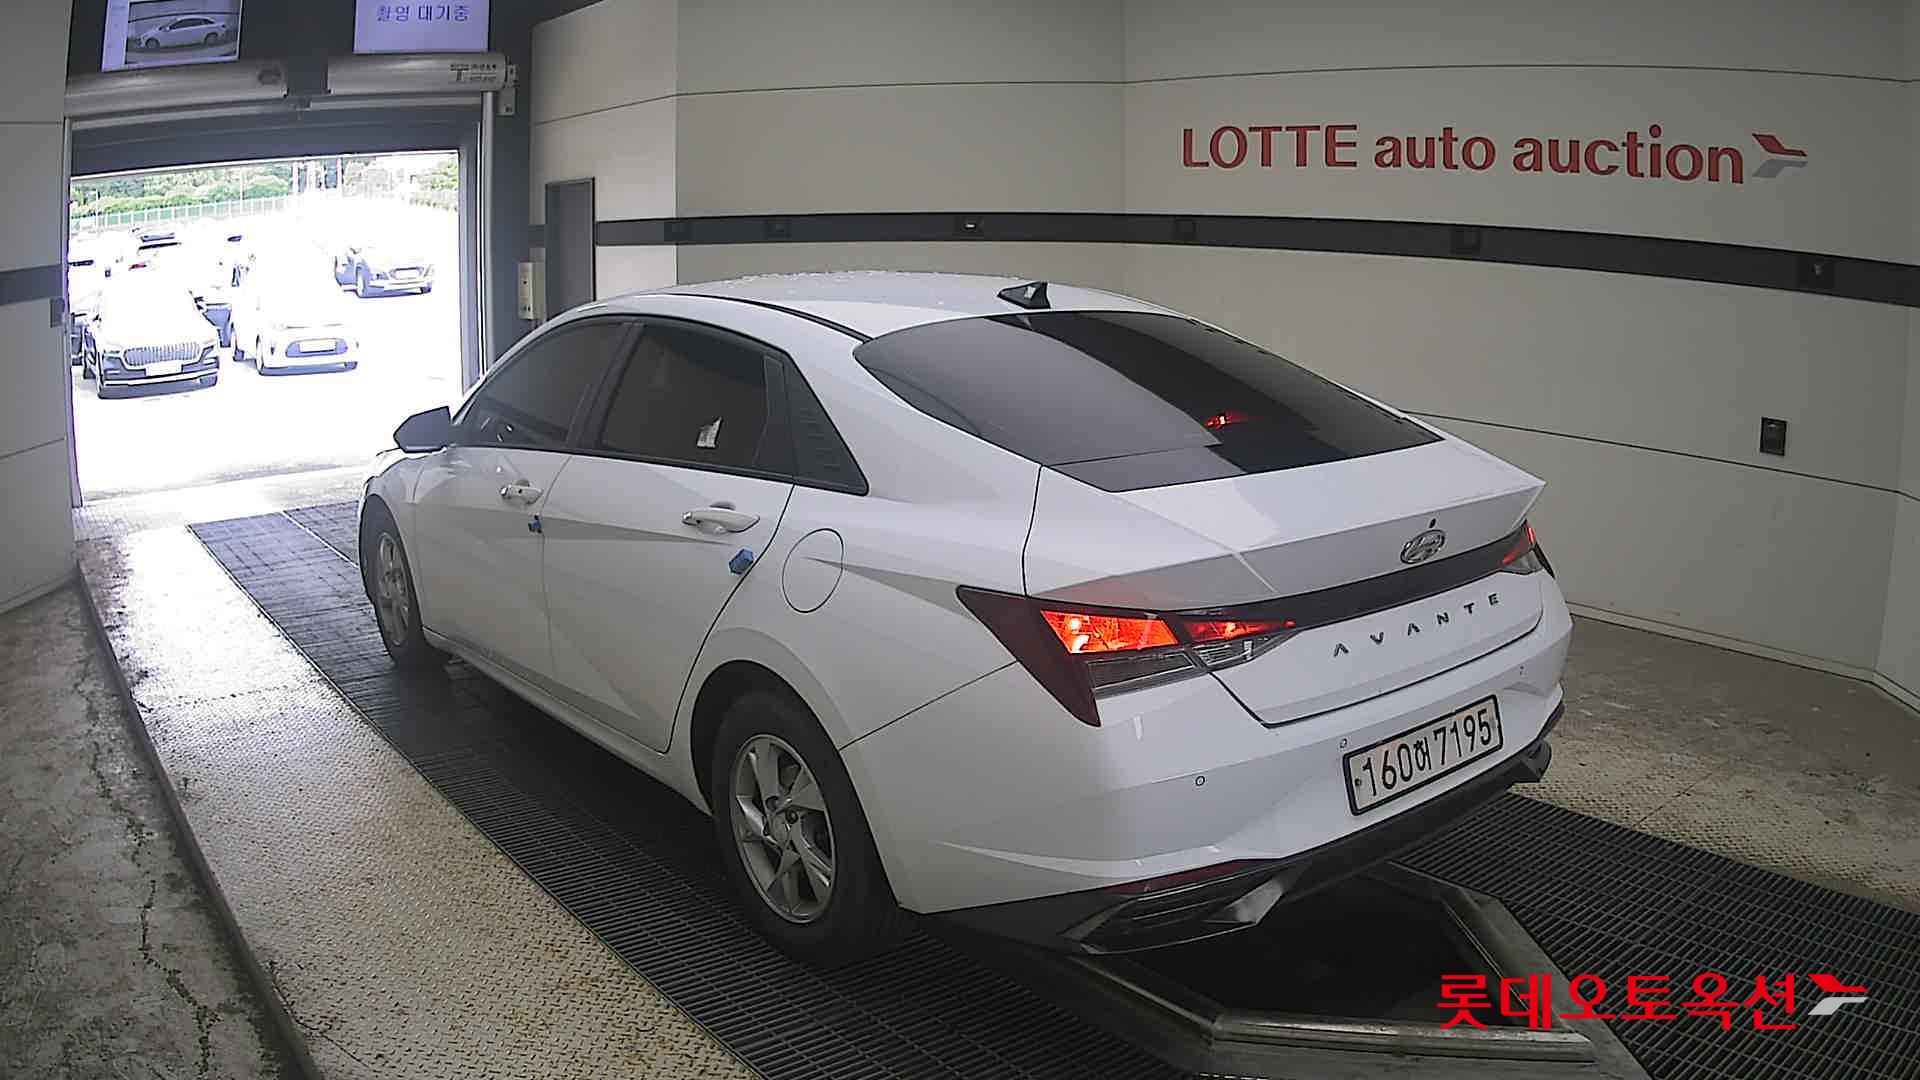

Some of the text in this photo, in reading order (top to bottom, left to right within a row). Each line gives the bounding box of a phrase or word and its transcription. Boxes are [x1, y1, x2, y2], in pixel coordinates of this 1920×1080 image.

[418, 5, 470, 22] 대기중
[1183, 124, 1744, 184] LOTTE auto auction
[1333, 593, 1499, 657] AVANTE
